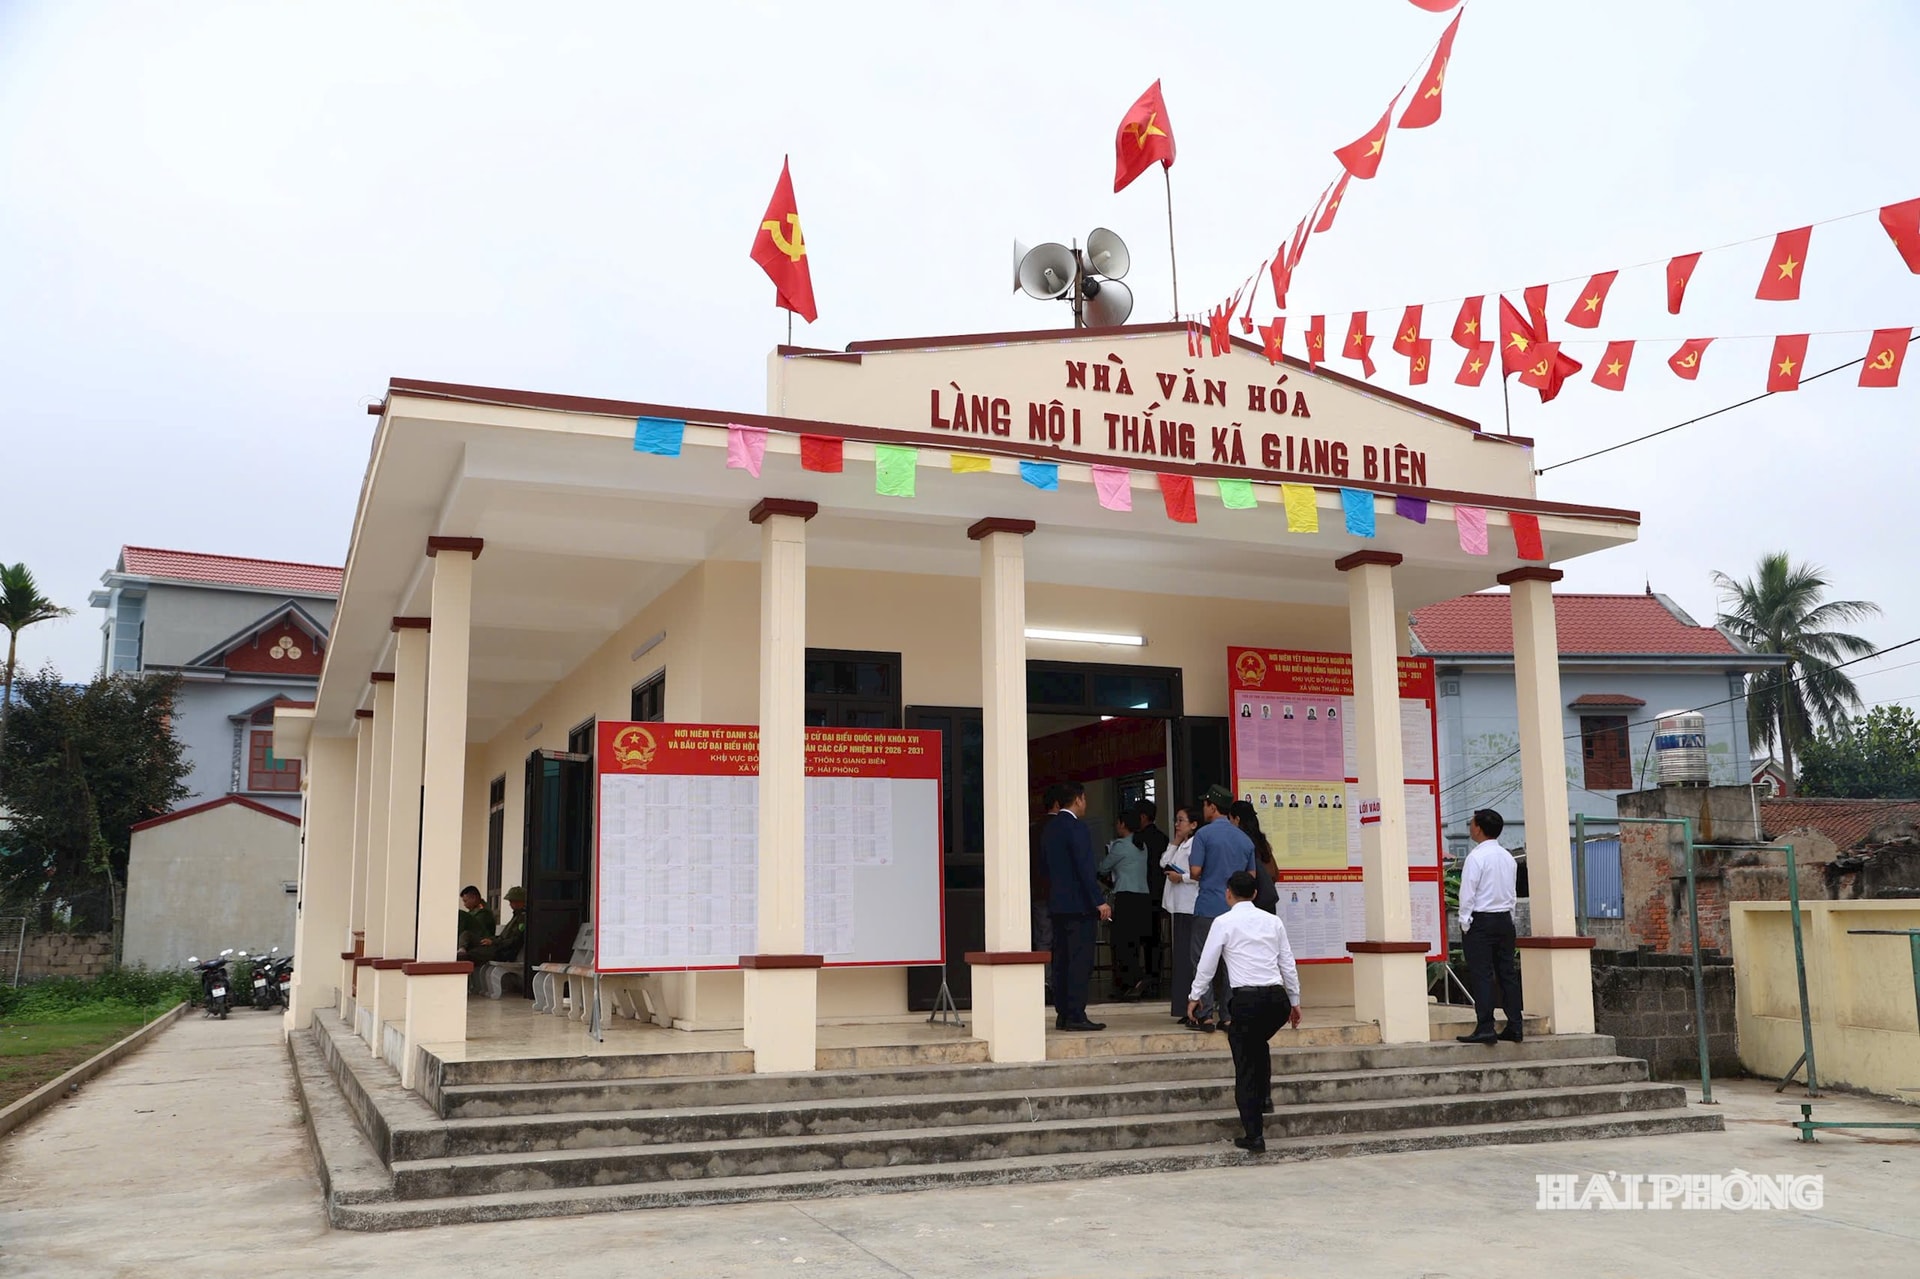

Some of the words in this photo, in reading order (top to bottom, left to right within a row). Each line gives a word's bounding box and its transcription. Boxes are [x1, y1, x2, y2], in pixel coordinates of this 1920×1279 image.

[1066, 353, 1133, 395] NHÀ
[1156, 368, 1226, 407] VĂN
[1248, 374, 1310, 417] HÓA
[931, 381, 1011, 436] LÀNG
[1029, 399, 1081, 449] NỘI
[1104, 402, 1195, 459] THẮNG
[1212, 422, 1246, 465] XÃ
[1261, 433, 1349, 478] GIANG
[1363, 443, 1427, 486] BIÊN
[674, 730, 688, 738] NƠI
[690, 728, 709, 738] NIÊM
[712, 728, 724, 739] YẾT
[726, 730, 746, 739] DANH
[810, 731, 821, 741] CỬ
[836, 732, 852, 742] BIỂU
[854, 732, 872, 743] QUỐC
[874, 734, 886, 744] HỘI
[888, 734, 906, 744] KHÓA
[908, 736, 919, 744] XVI
[668, 740, 678, 749] VÀ
[697, 739, 708, 750] CỬ
[710, 742, 722, 752] ĐẠI
[724, 740, 740, 750] BIỂU
[742, 742, 755, 752] HỘI
[818, 744, 832, 752] CÁC
[834, 743, 848, 753] CẤP
[850, 744, 872, 754] NHIỆM
[908, 747, 924, 755] 2031
[1359, 801, 1368, 814] LỐI
[1369, 801, 1380, 812] VÀO
